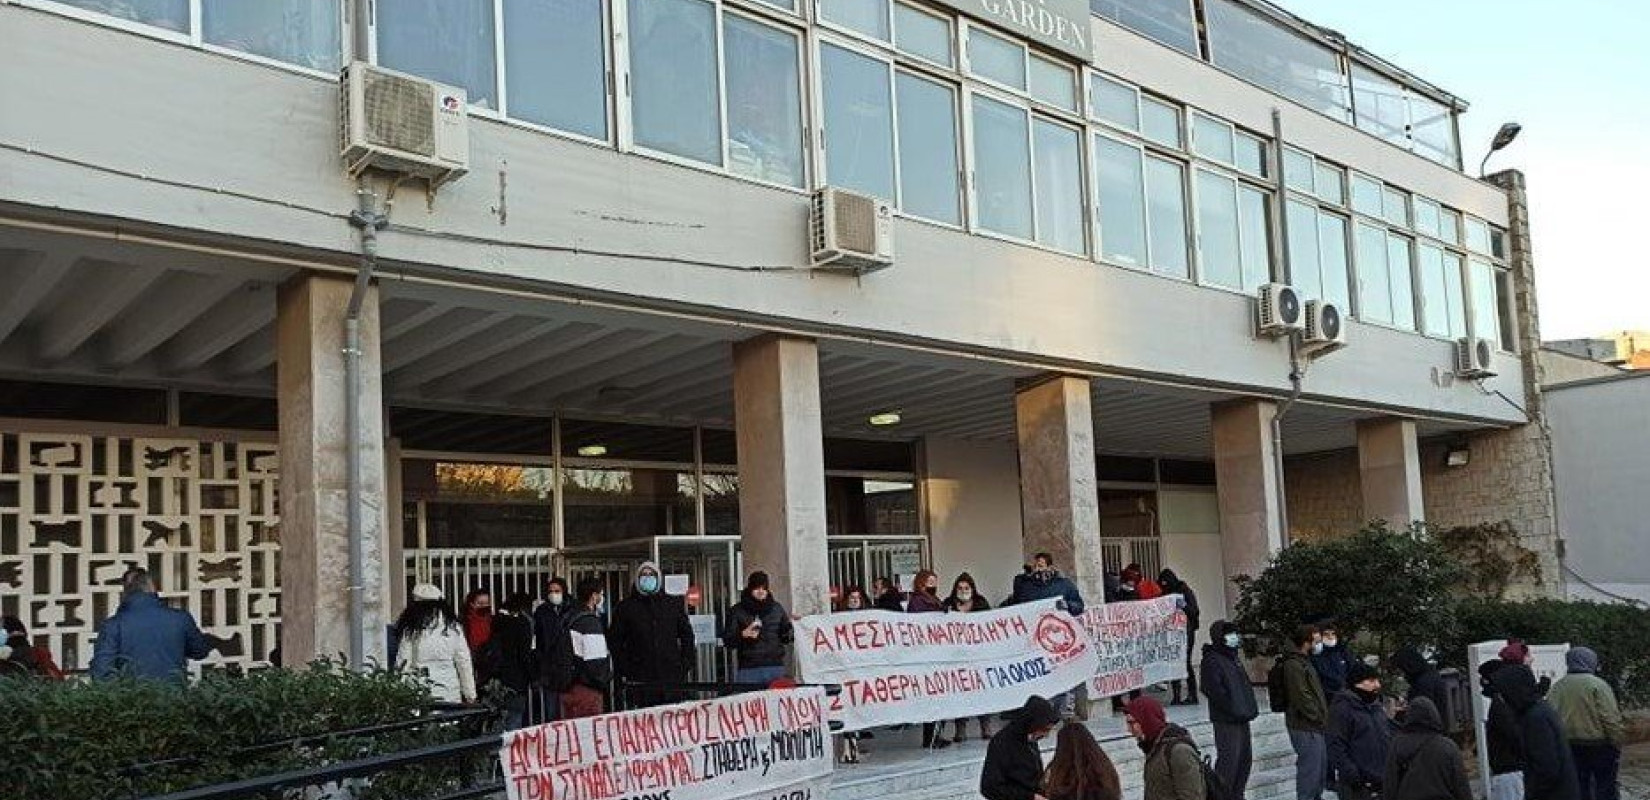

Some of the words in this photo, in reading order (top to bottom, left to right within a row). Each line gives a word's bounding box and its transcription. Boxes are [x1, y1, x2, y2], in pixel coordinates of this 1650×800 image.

[981, 0, 1085, 49] GARDEN
[813, 619, 896, 654] ΑΜΕΣΗ
[925, 668, 986, 696] ΔΟΥΛΕΙΑ
[985, 666, 1012, 690] ΓΙΑ
[509, 721, 583, 774] ΑΜΕΣΗ
